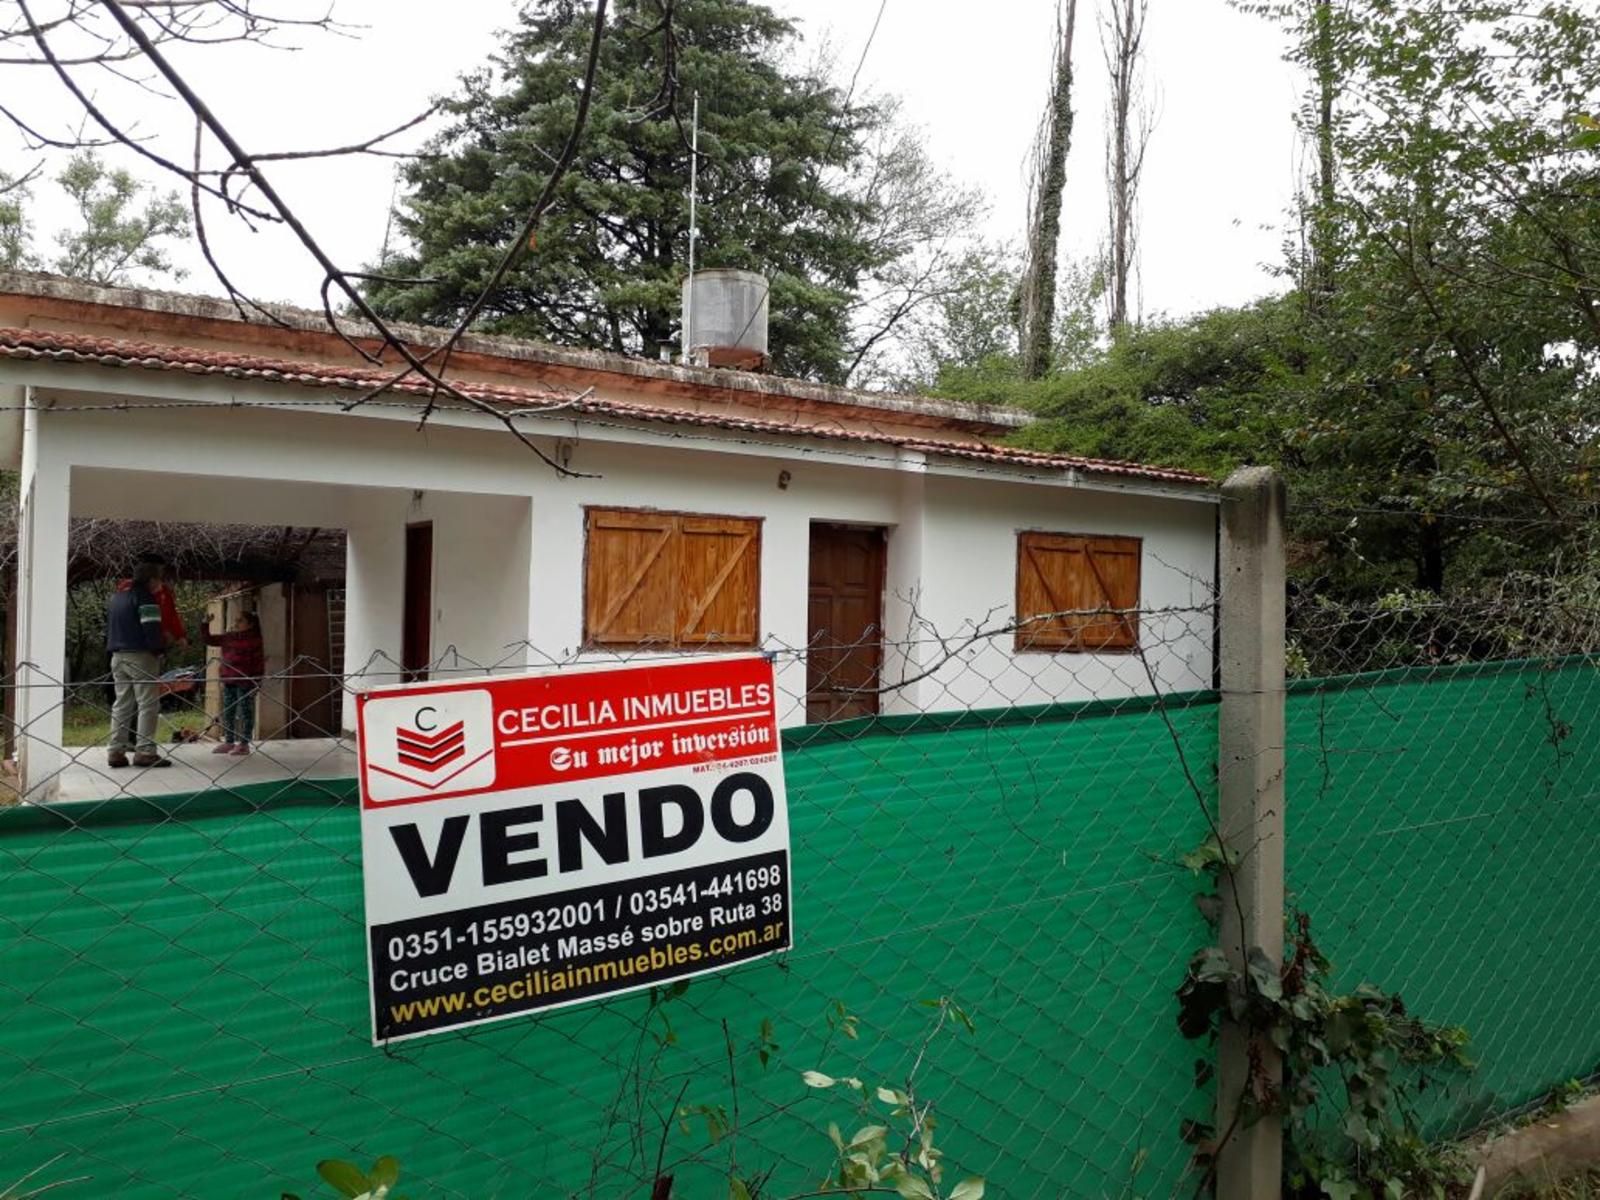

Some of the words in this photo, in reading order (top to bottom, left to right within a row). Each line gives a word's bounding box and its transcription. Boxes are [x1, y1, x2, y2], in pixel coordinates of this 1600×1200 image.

[415, 706, 437, 731] C
[497, 699, 617, 735] CECILIA
[624, 683, 771, 721] INMUEBLES
[598, 738, 664, 767] mejor
[672, 724, 770, 756] inversión
[389, 772, 775, 898] VENDO
[388, 898, 605, 962] 0351-155932001
[615, 894, 622, 918] /
[630, 864, 781, 915] 03541-441698
[390, 962, 469, 992] Cruce
[477, 942, 550, 975] Bialet
[558, 925, 634, 960] Massé
[641, 915, 704, 942] sobre
[710, 903, 756, 928] Ruta
[762, 893, 782, 915] 38
[390, 922, 784, 1023] www.ceciliainmuebles.com.ar
